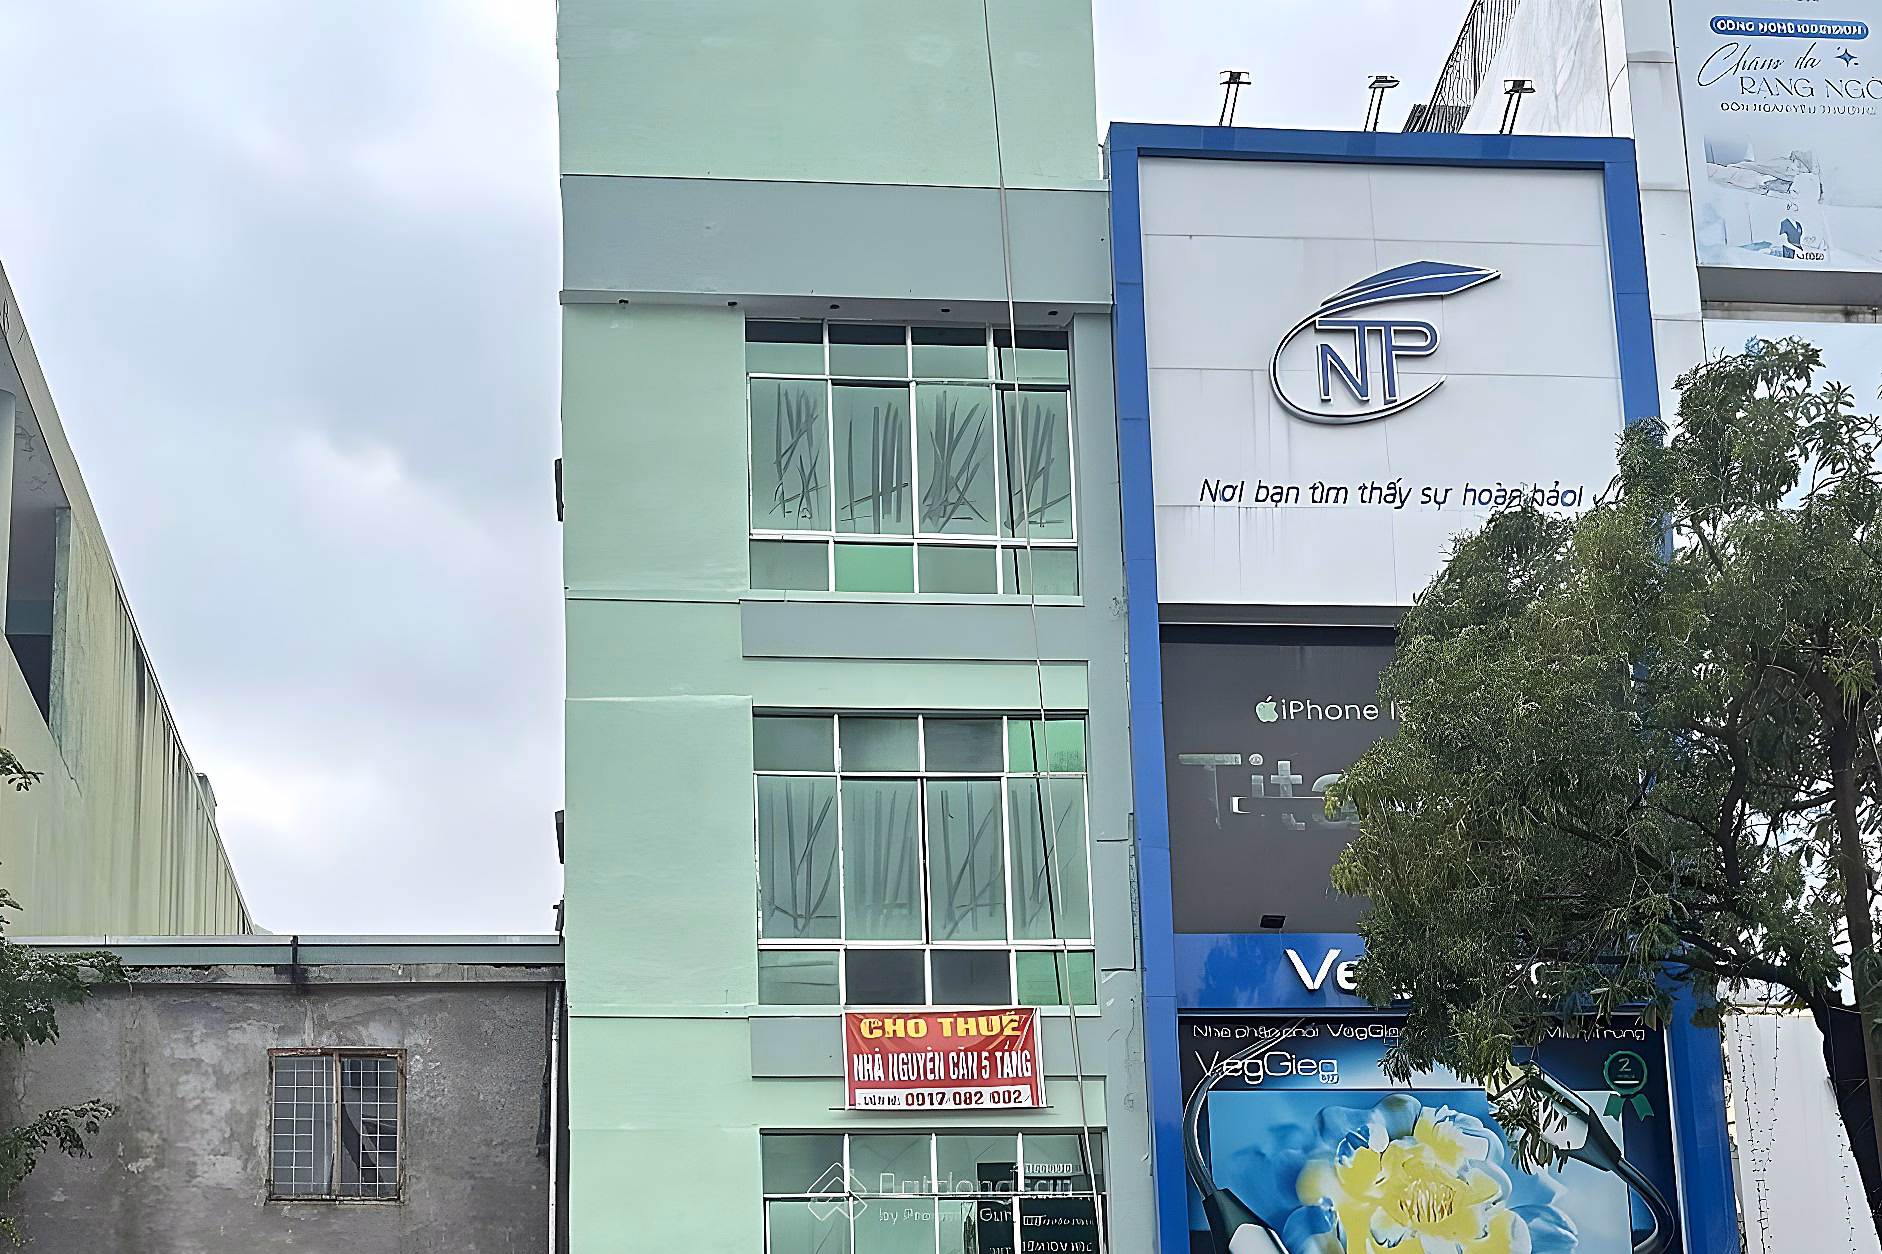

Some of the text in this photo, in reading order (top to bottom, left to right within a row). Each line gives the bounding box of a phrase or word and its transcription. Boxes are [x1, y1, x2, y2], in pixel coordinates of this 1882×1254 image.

[1314, 316, 1442, 405] NTP
[1254, 479, 1300, 508] bạn
[1358, 478, 1412, 509] thấy
[1421, 486, 1452, 511] sự
[1281, 698, 1379, 721] iPhone
[860, 1018, 928, 1039] CHO
[853, 1048, 885, 1082] NHÀ
[981, 1052, 990, 1080] 5
